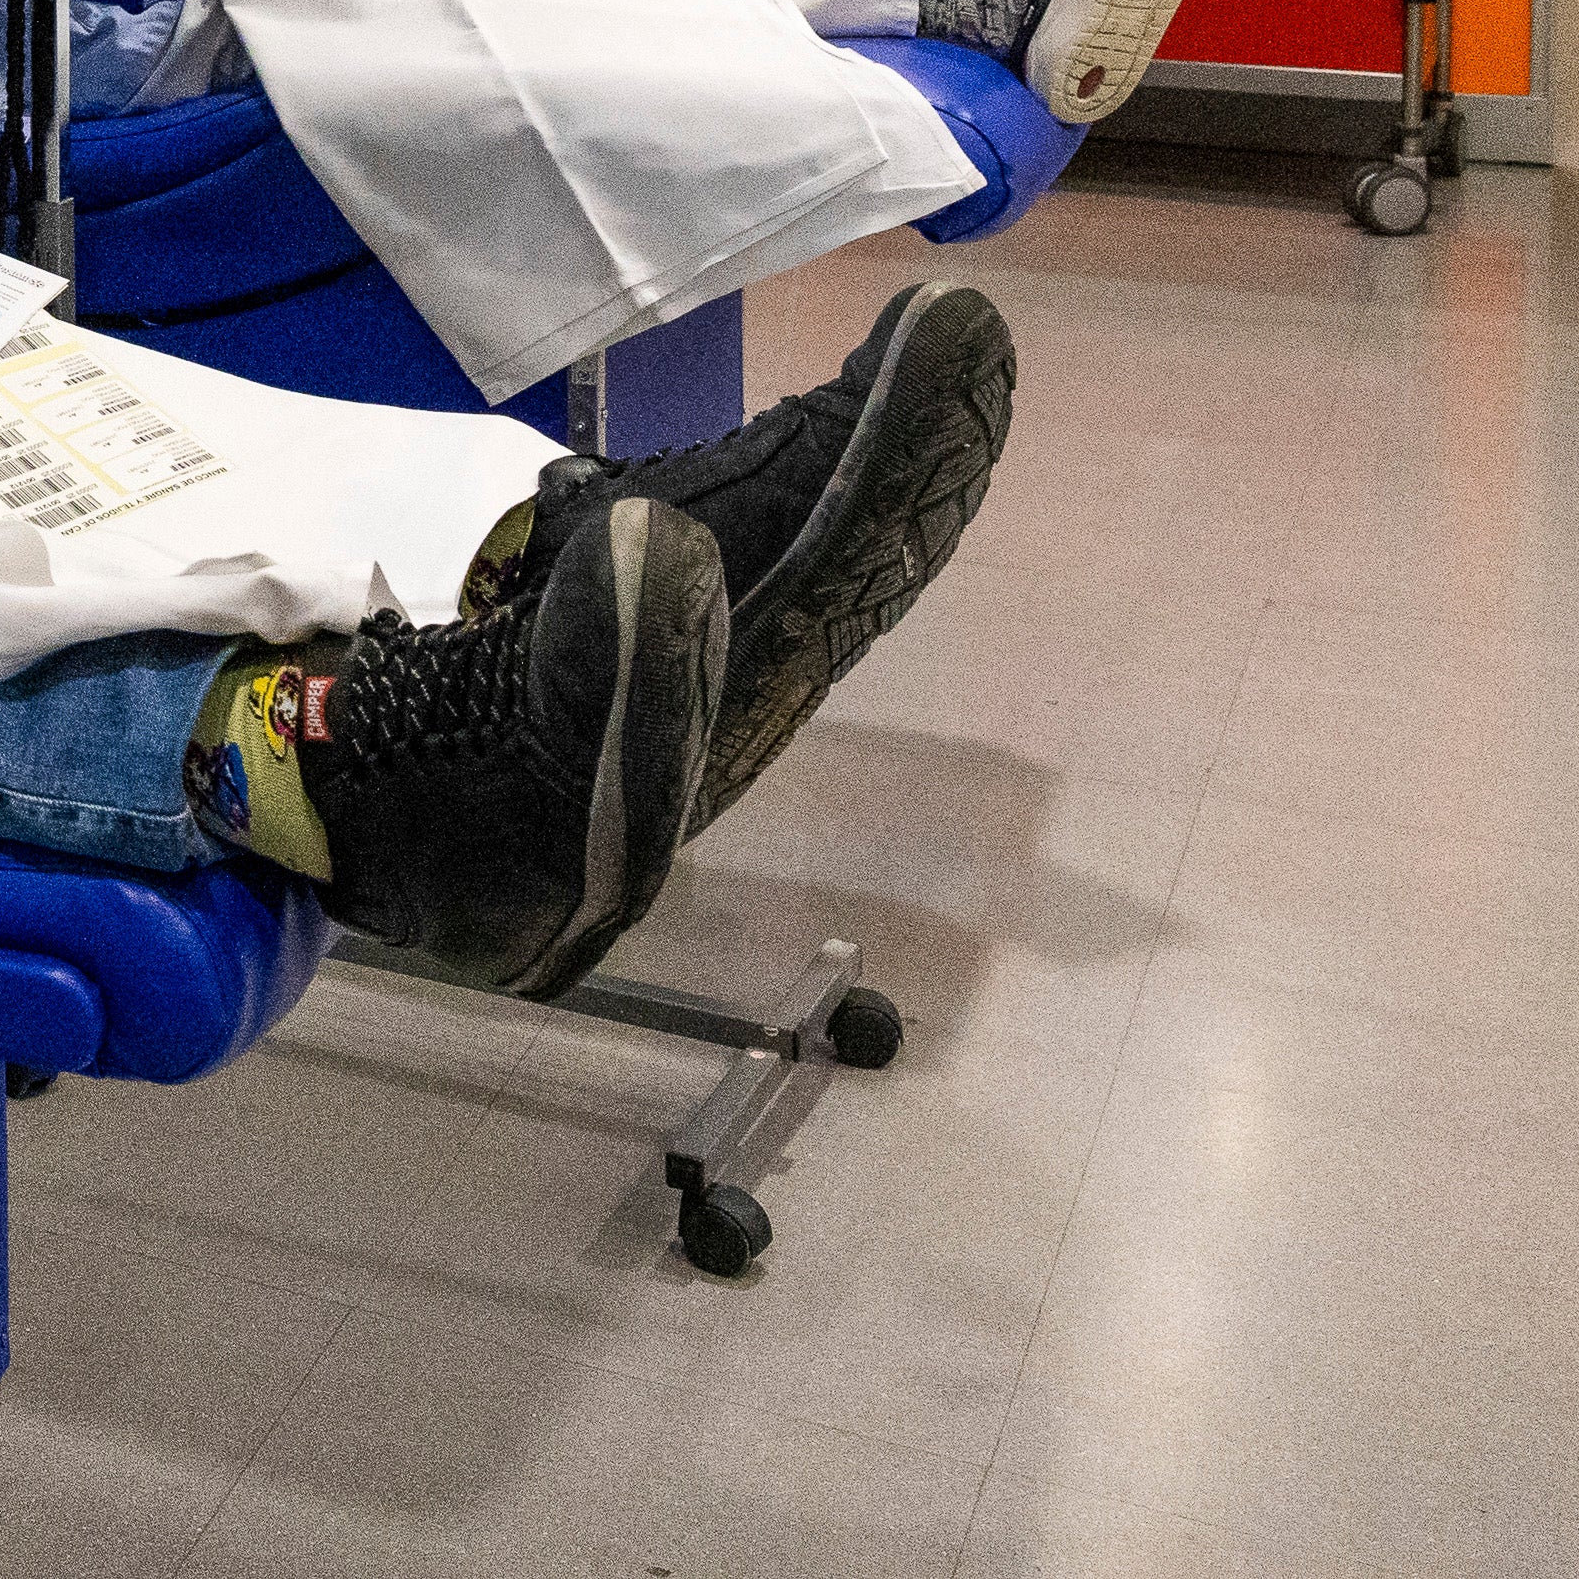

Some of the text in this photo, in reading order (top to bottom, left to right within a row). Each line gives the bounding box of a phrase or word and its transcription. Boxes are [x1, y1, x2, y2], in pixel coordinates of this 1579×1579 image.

[200, 466, 229, 482] BANCO
[10, 476, 36, 489] 001212
[182, 477, 197, 489] DE
[144, 481, 182, 503] SANGRE
[34, 498, 61, 513] 001212
[94, 501, 136, 523] TEJIDOS
[60, 523, 82, 538] CAN
[81, 518, 95, 530] DE
